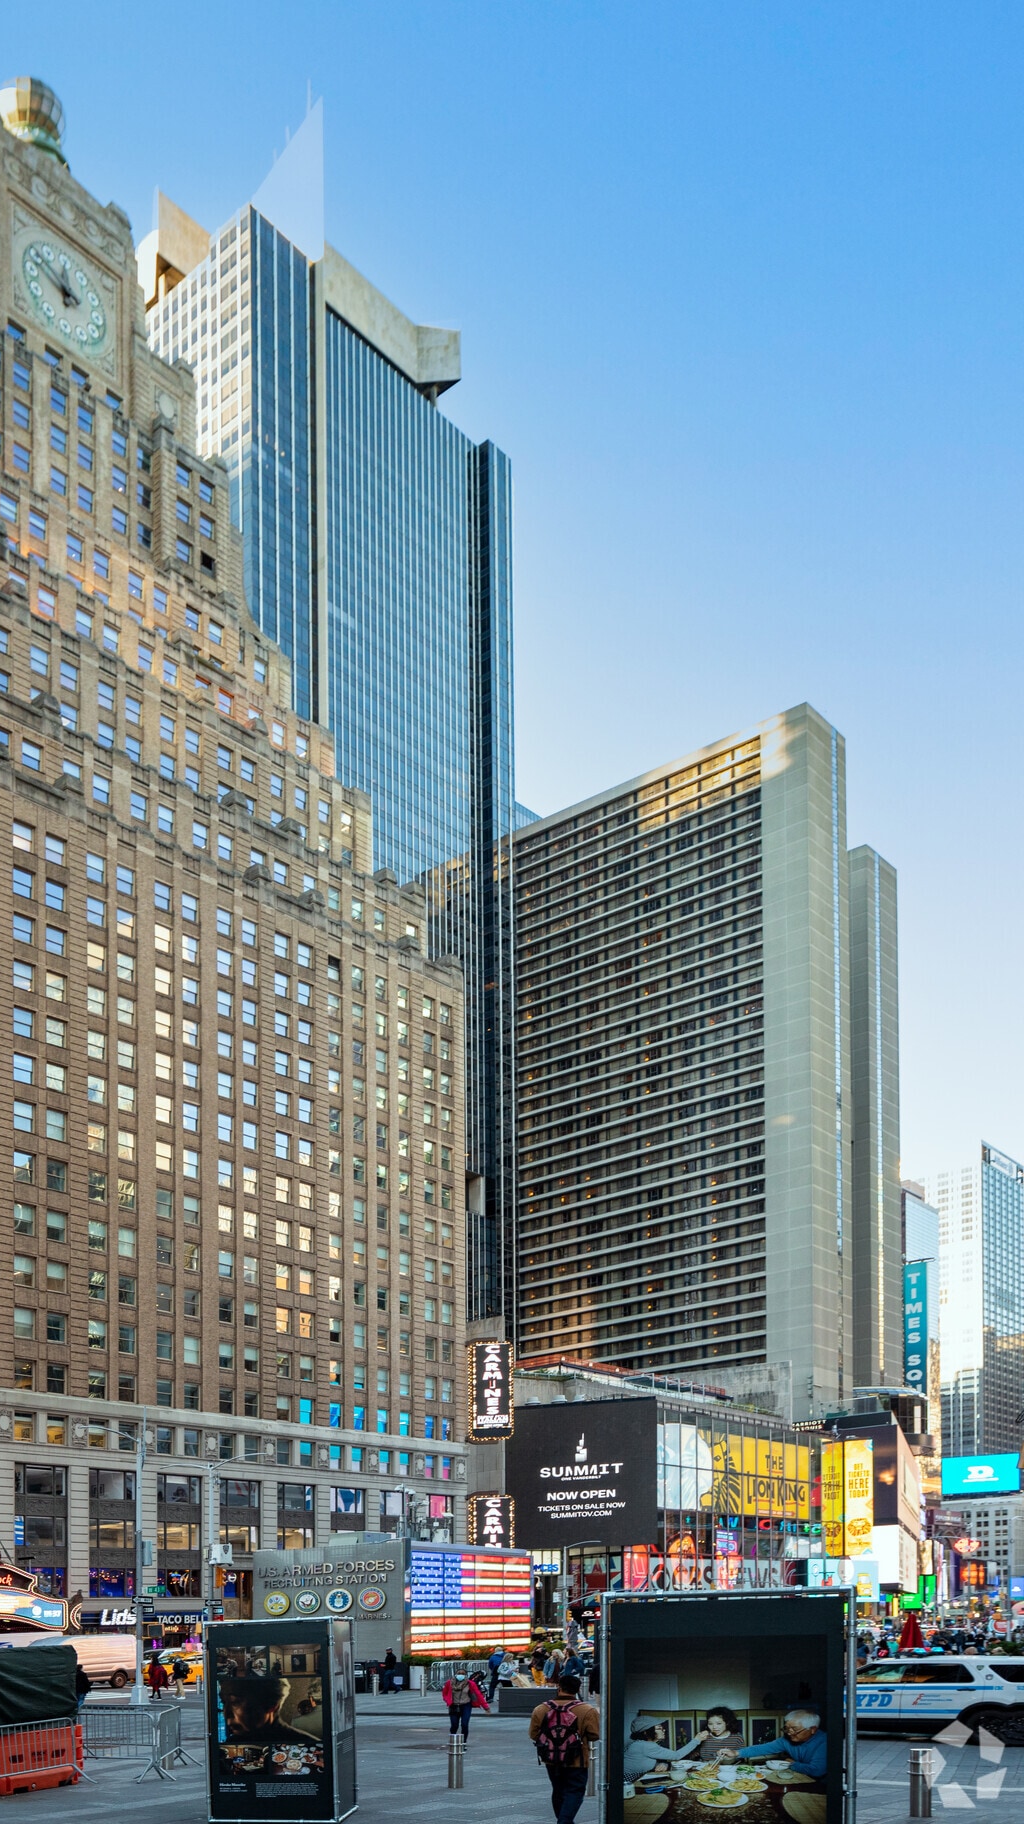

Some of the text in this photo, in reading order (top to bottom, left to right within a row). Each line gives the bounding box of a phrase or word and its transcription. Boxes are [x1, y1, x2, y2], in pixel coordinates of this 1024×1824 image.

[905, 1272, 923, 1344] TIMES
[540, 1462, 624, 1478] SUMMIT
[765, 1454, 784, 1470] THE
[747, 1471, 806, 1506] LION KING
[848, 1478, 870, 1490] HERE
[547, 1489, 616, 1501] NOW OPEN
[849, 1490, 869, 1498] TODAY
[550, 1510, 612, 1519] SUMMITOV.COM
[258, 1559, 395, 1578] U.S. ARMED FORCES
[264, 1573, 387, 1589] RECRUITING STATION
[100, 1608, 137, 1626] Lids
[157, 1615, 182, 1624] TACO
